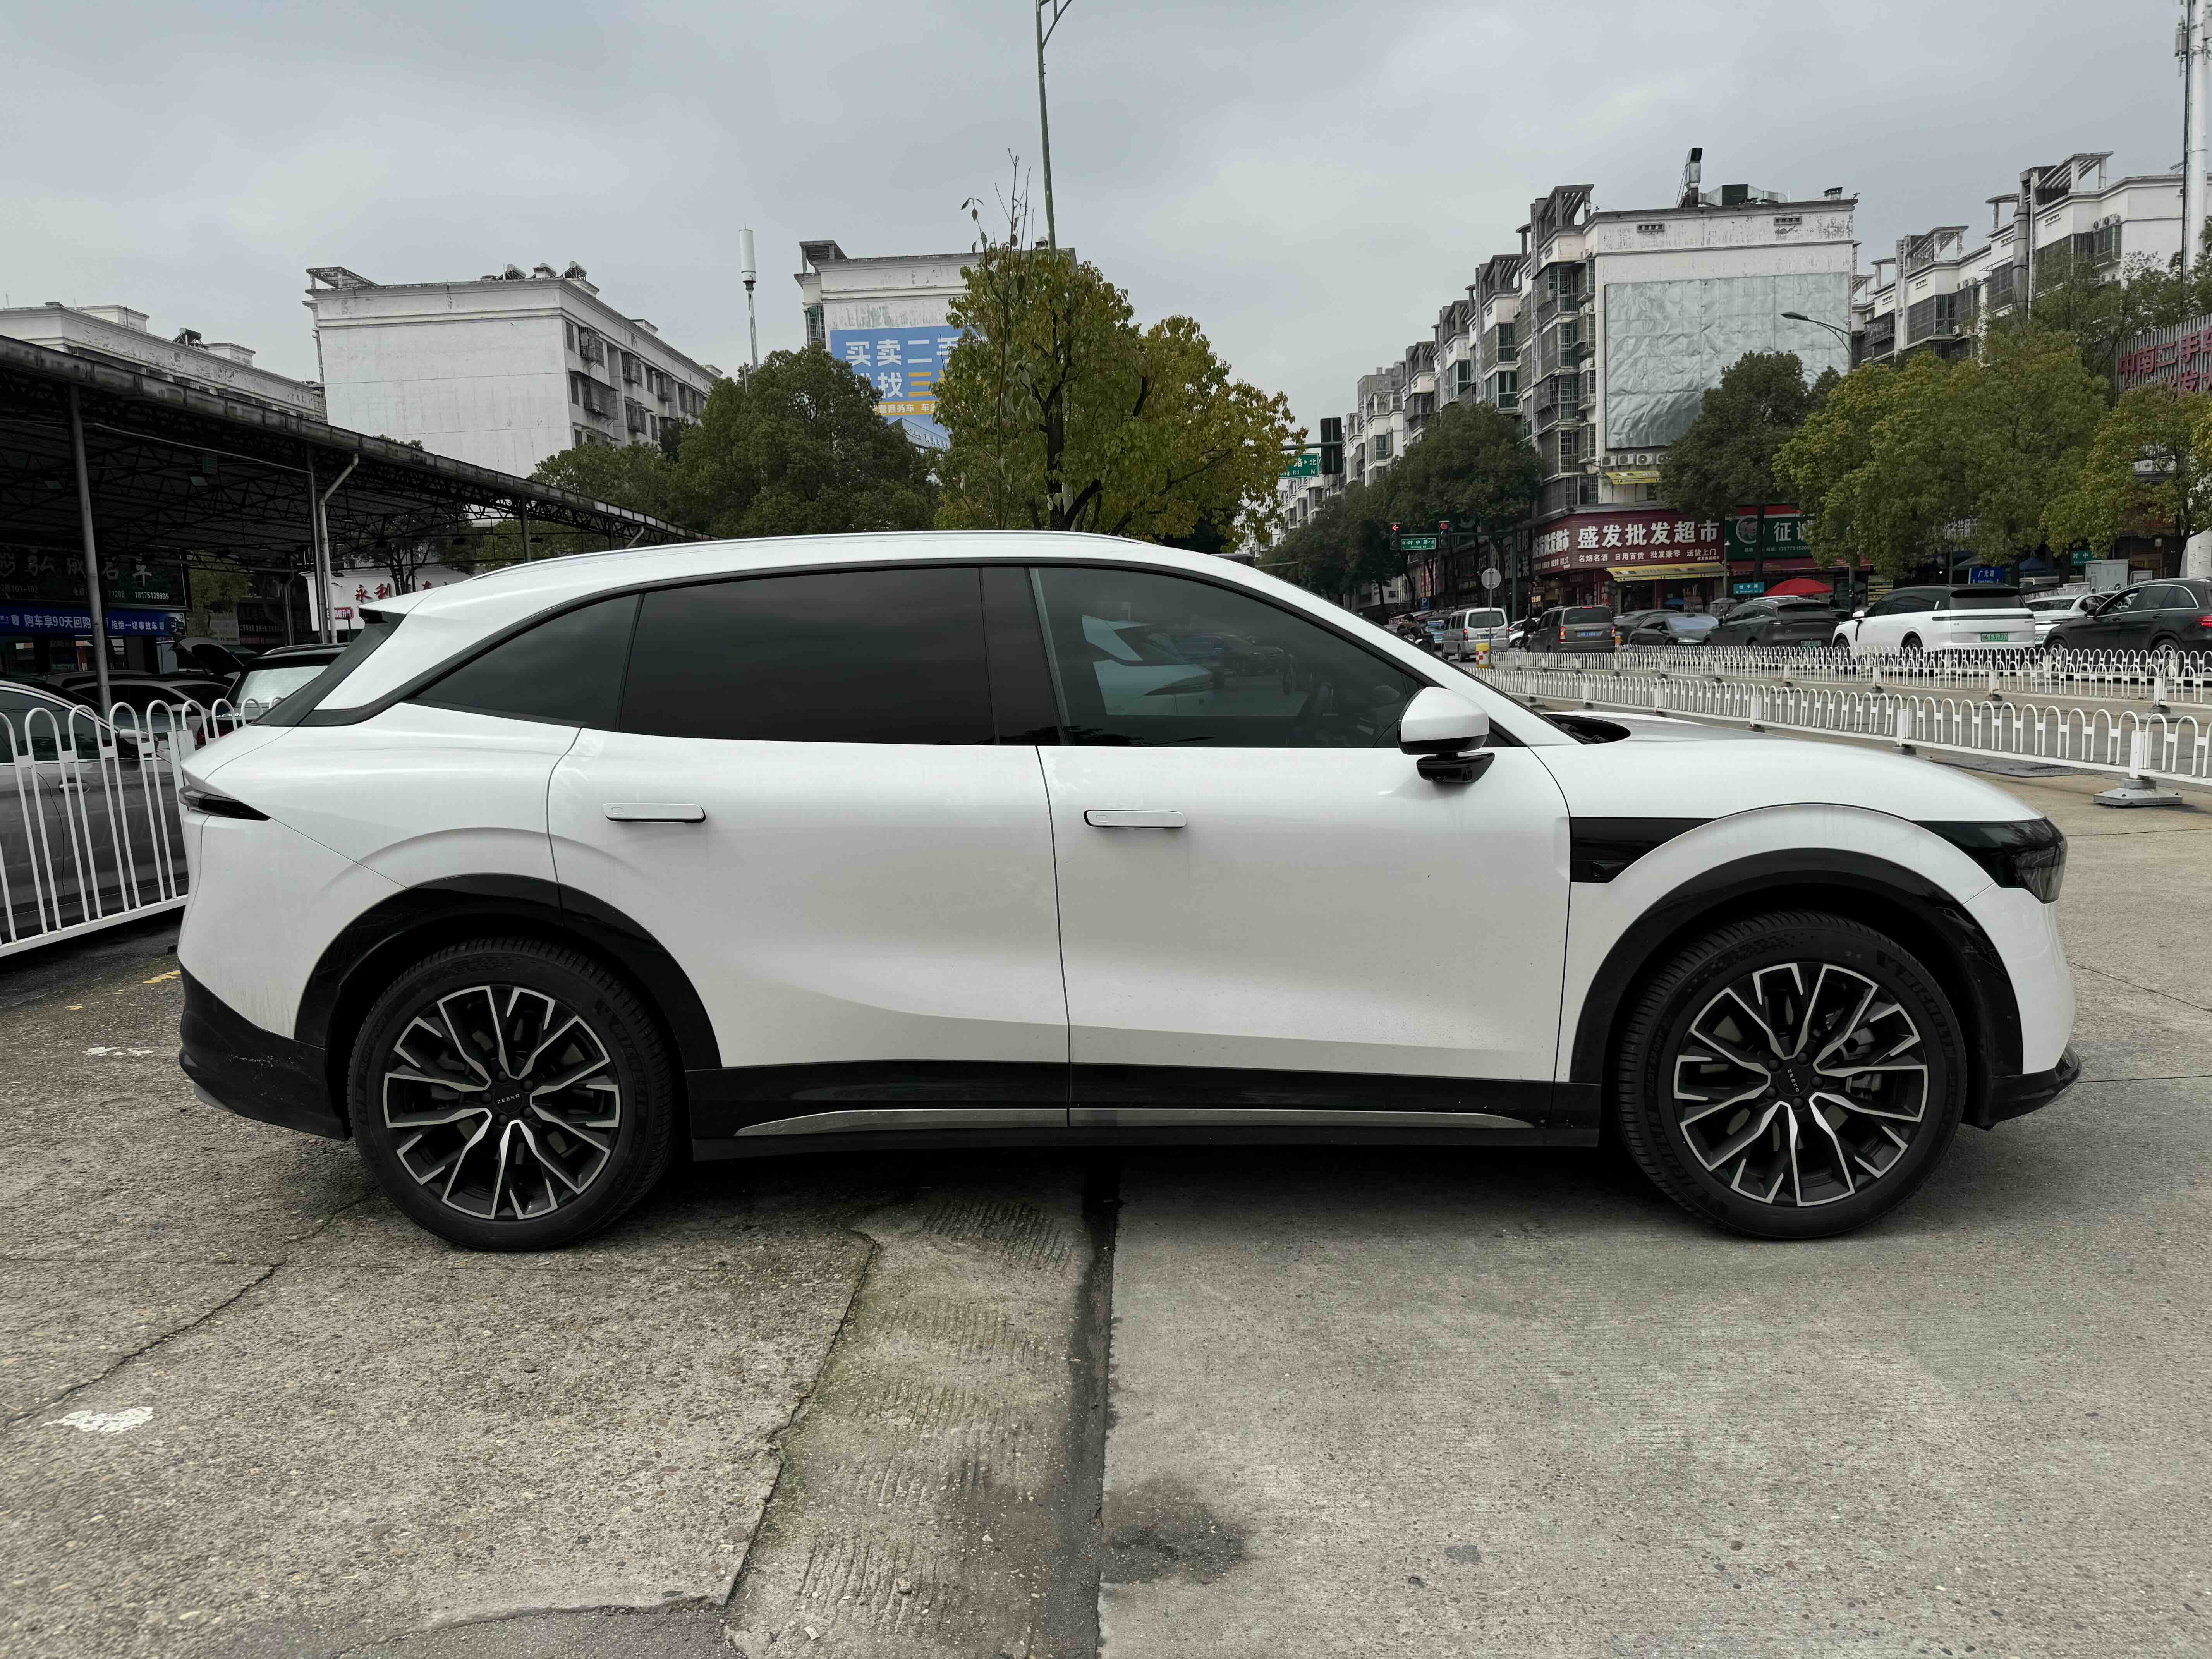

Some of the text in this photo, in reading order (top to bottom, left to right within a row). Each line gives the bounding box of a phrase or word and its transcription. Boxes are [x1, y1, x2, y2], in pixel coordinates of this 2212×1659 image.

[1309, 458, 1317, 466] 北
[1577, 520, 1719, 549] 盛发批发超市
[1578, 548, 1717, 563] 名烟名酒 日用百货 批发兼零 送货上门
[1422, 598, 1427, 606] P
[24, 614, 92, 629] 购车享90天回购
[112, 620, 158, 631] 拒绝一切事故车
[1787, 1068, 1800, 1092] ZEEKR
[496, 1094, 520, 1104] ZEEKR
